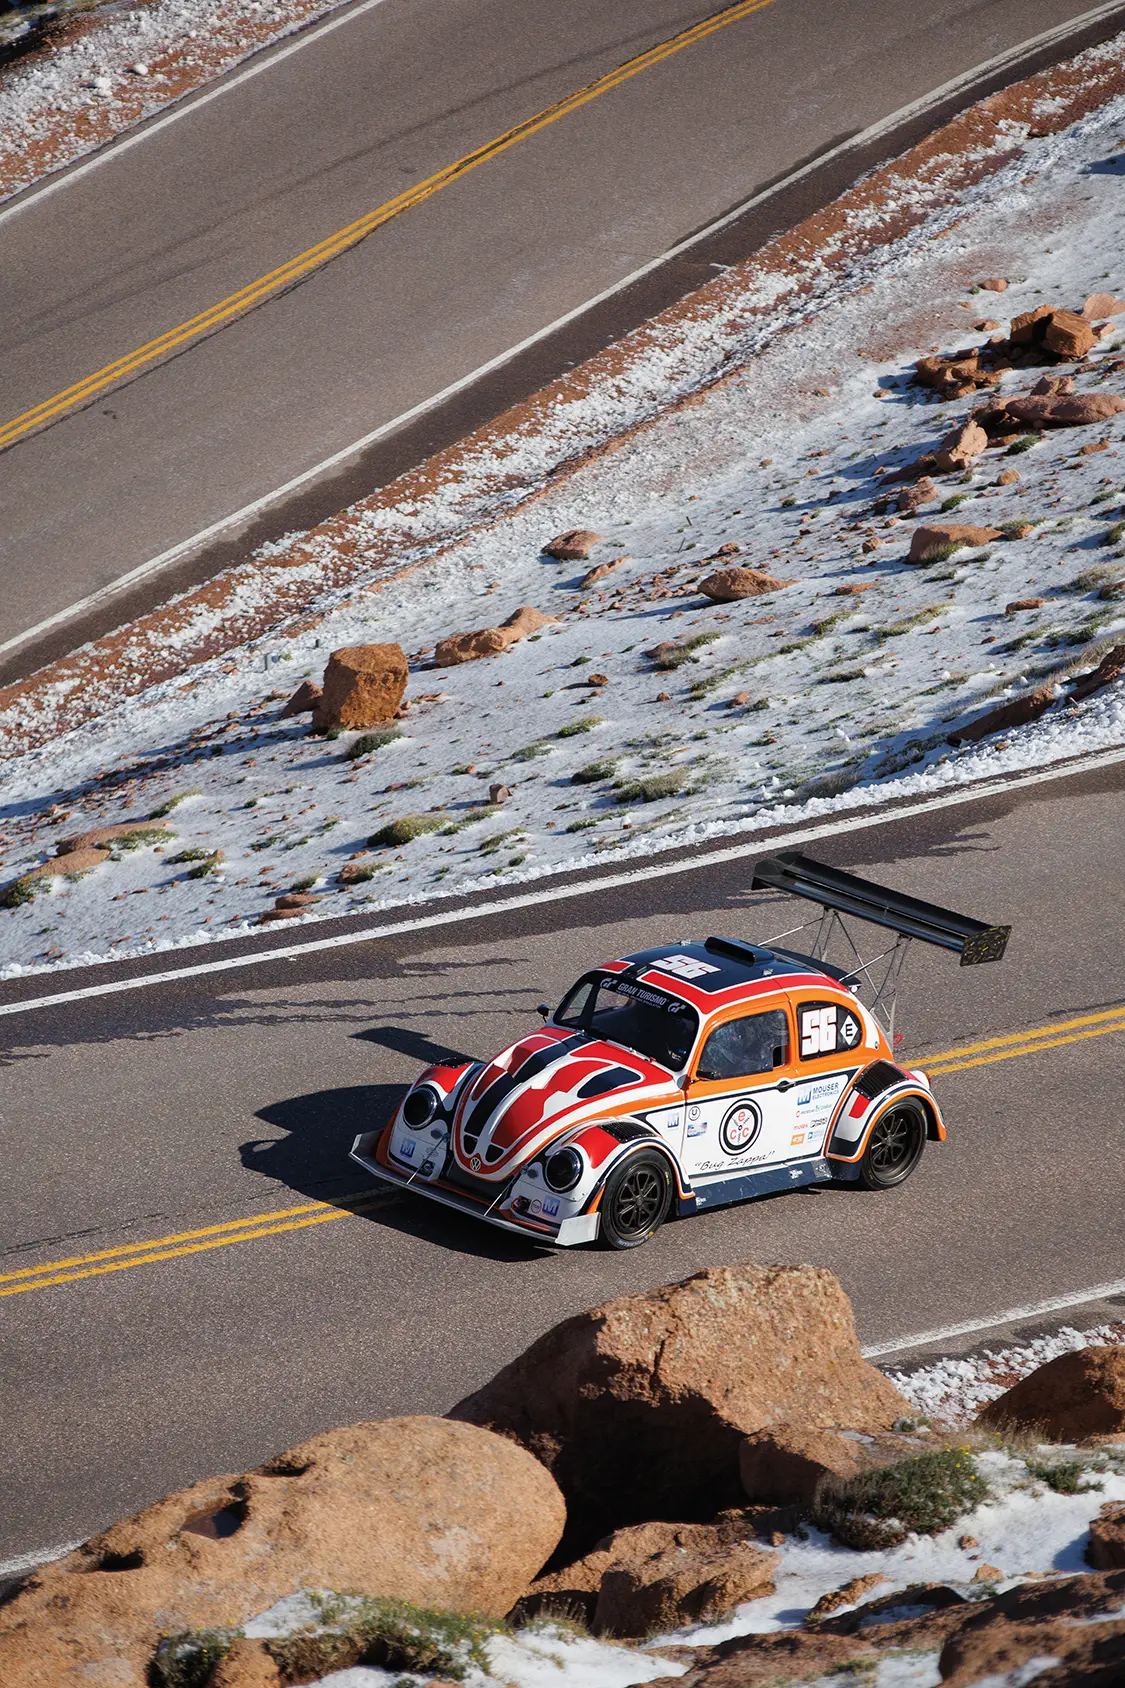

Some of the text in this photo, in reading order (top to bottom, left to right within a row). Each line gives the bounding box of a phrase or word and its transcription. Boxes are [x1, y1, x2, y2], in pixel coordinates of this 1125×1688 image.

[649, 954, 721, 979] 56
[618, 983, 637, 995] GRAN
[636, 990, 668, 1006] TURISMO
[802, 1006, 837, 1056] 56
[845, 1023, 853, 1037] E
[812, 1082, 839, 1094] MOUSER
[812, 1089, 839, 1100] ELECTRONICS
